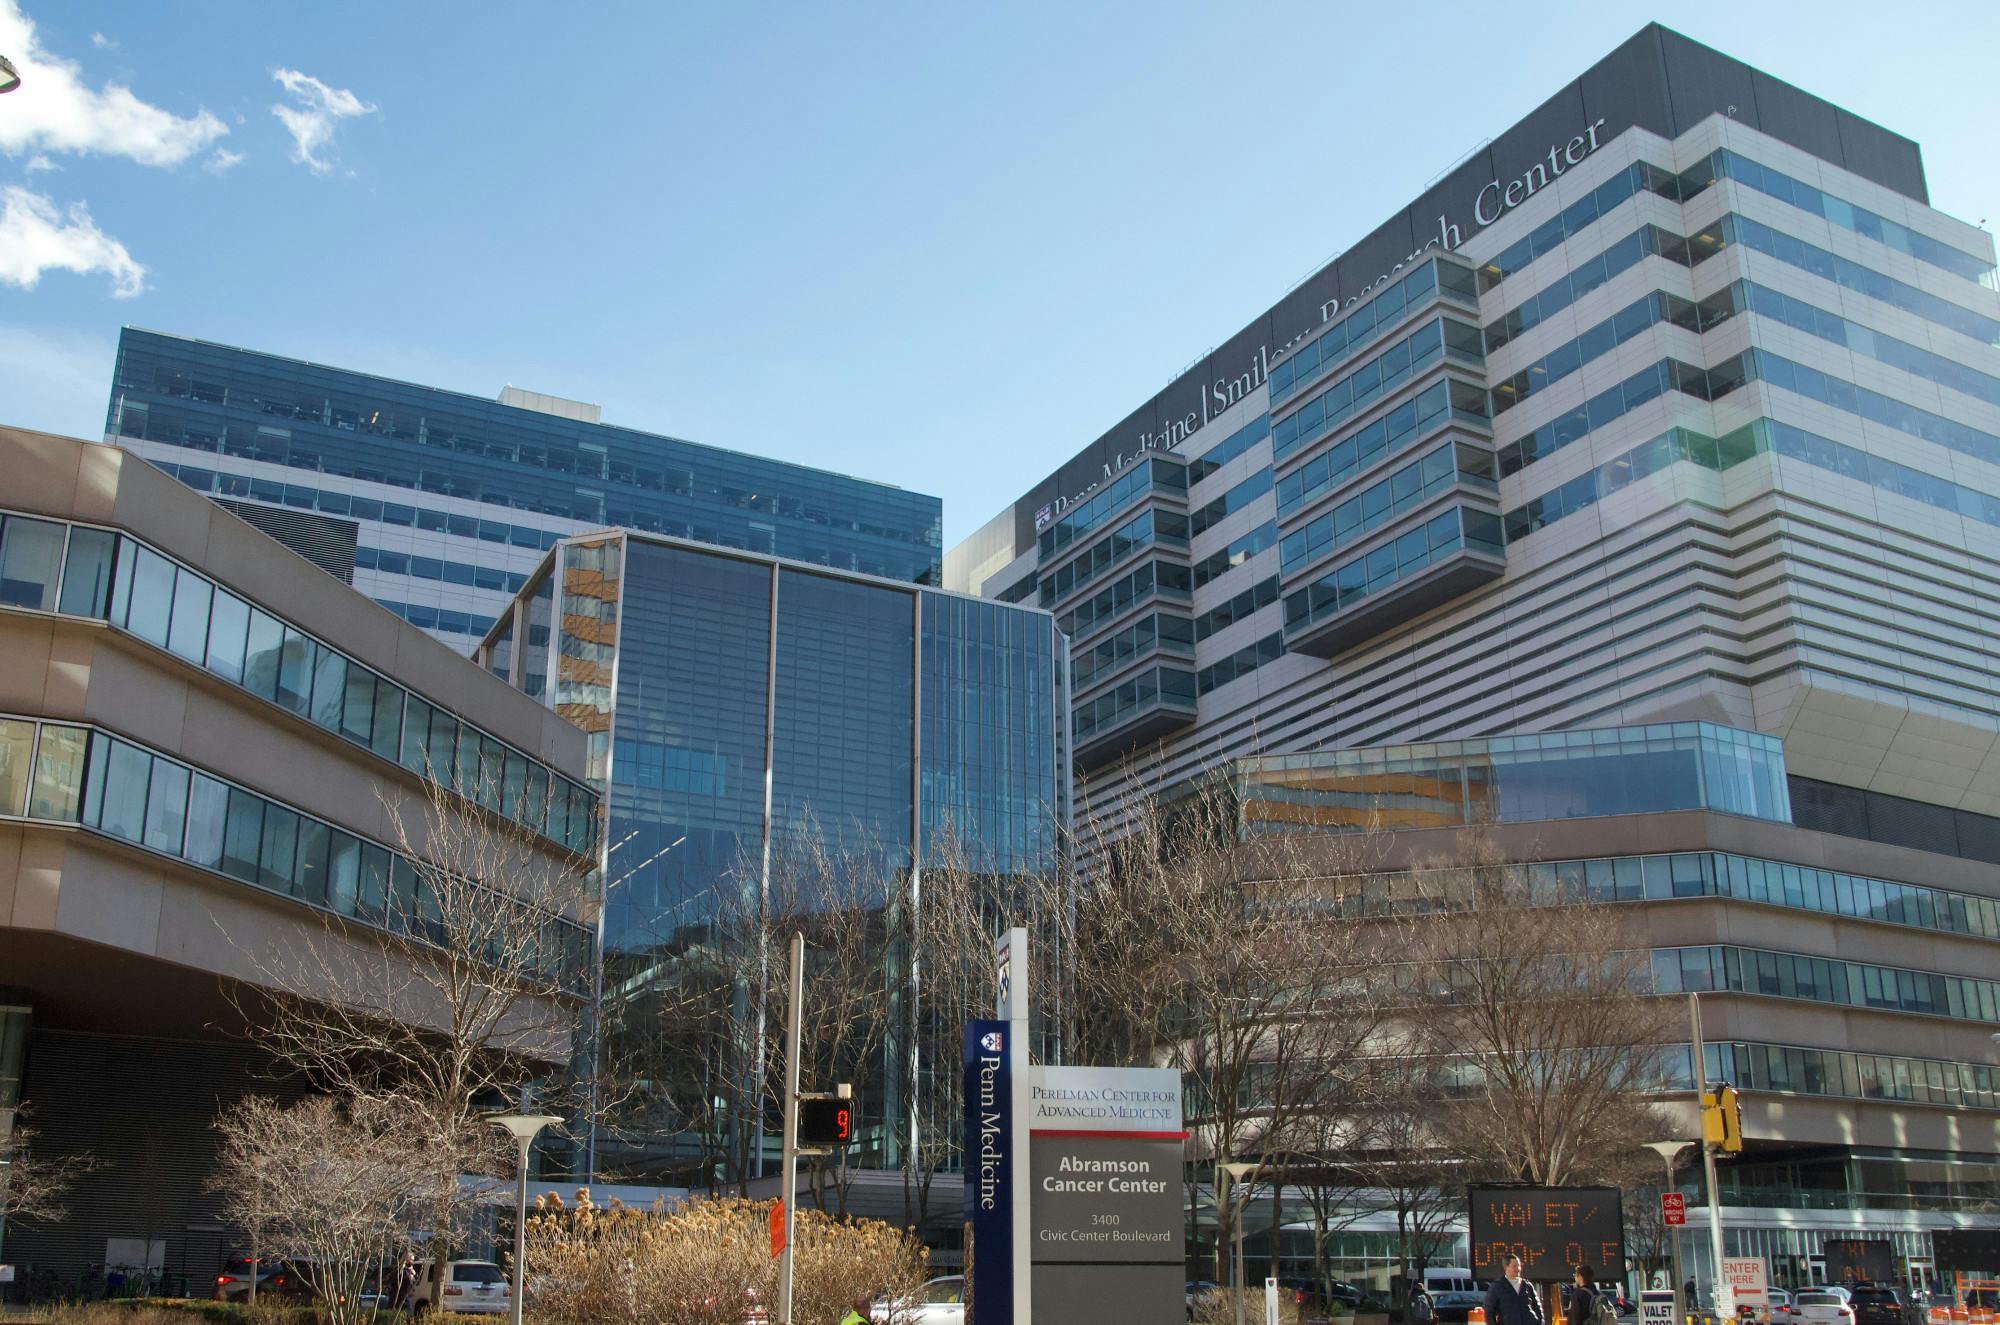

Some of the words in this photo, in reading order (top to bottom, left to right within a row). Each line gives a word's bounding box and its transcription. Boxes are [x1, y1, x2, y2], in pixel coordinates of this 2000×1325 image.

[1103, 412, 1198, 480] Mdicine
[1213, 327, 1311, 416] Smil
[1474, 118, 1606, 227] Center
[980, 1056, 1000, 1106] Penn
[1032, 1086, 1100, 1101] PERELMAN
[1102, 1088, 1152, 1102] CENTER
[1153, 1091, 1176, 1102] FOR
[1037, 1104, 1106, 1118] ADVANCED
[1109, 1105, 1172, 1119] MEDICINE
[837, 1109, 850, 1139] 9
[980, 1112, 1003, 1210] Medicine
[1059, 1156, 1150, 1173] Abramson
[1043, 1176, 1104, 1193] Cancer
[1108, 1177, 1167, 1193] Center
[1091, 1214, 1120, 1225] 3400
[1040, 1229, 1068, 1241] Civic
[1070, 1230, 1110, 1241] Center
[1112, 1230, 1171, 1242] Boulevard
[1565, 1241, 1619, 1267] OF
[1723, 1263, 1760, 1274] ENTER
[1729, 1275, 1755, 1284] HERE
[1643, 1305, 1673, 1318] VALET
